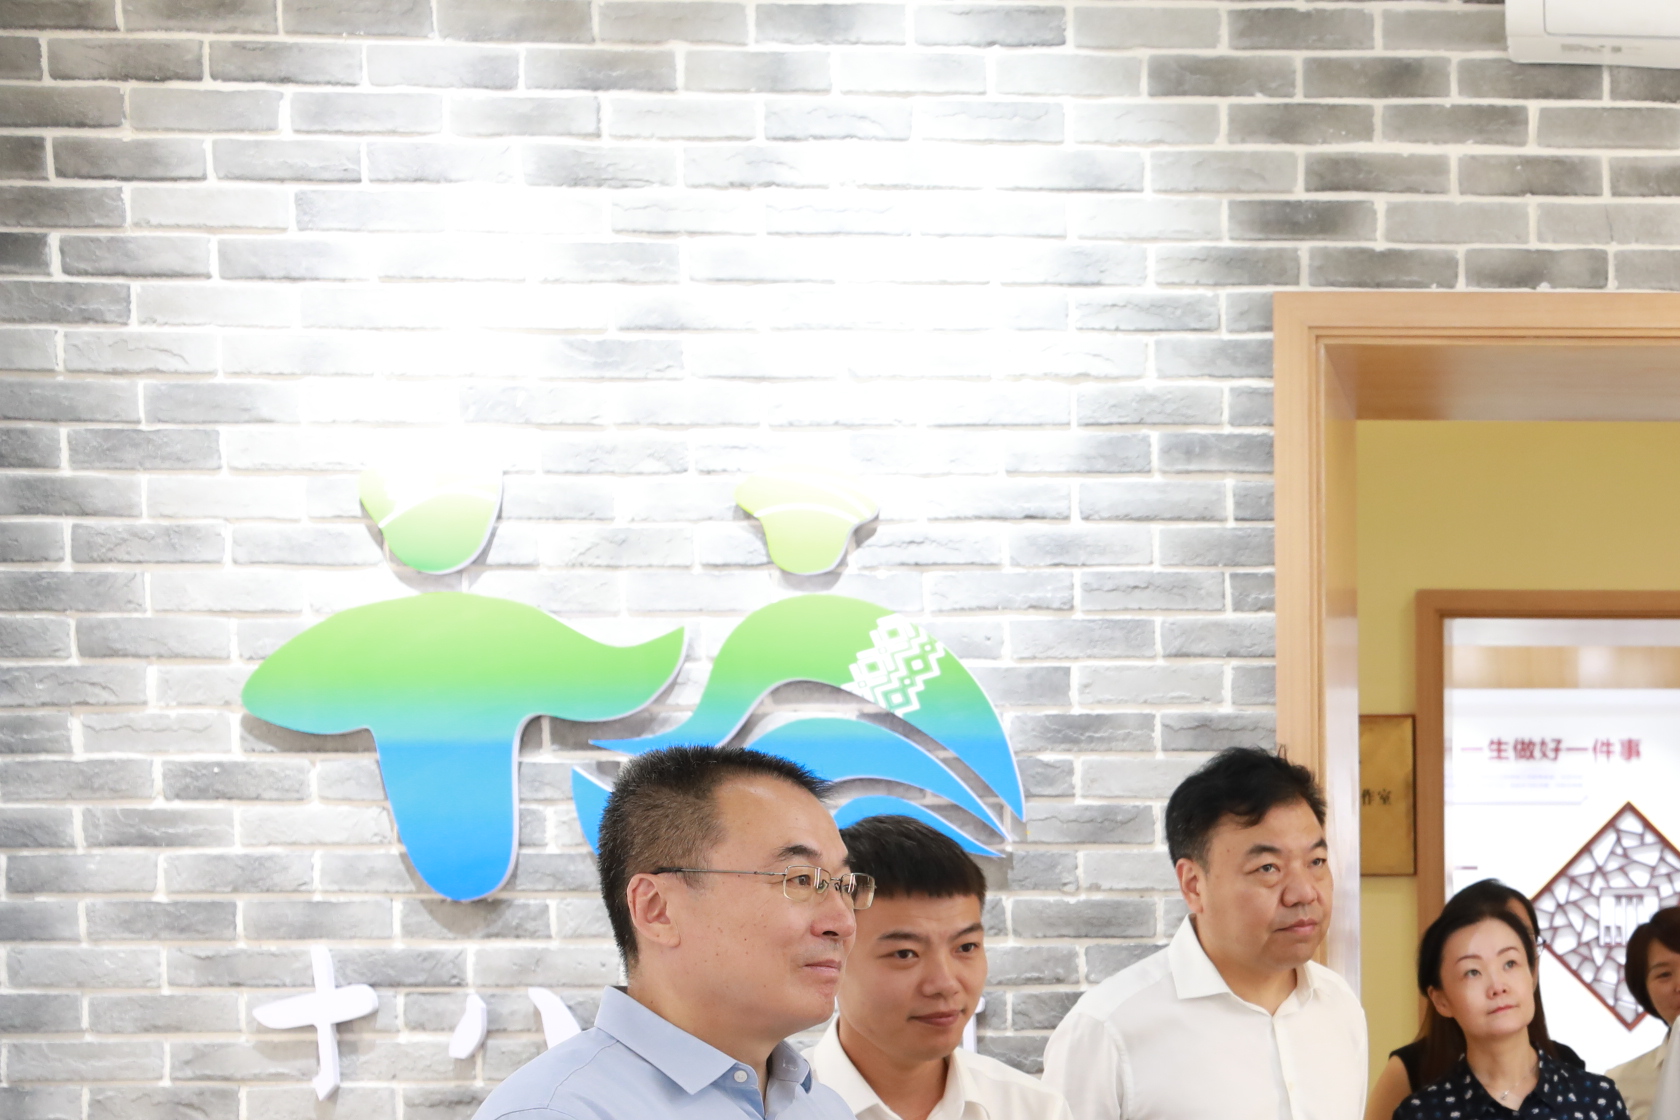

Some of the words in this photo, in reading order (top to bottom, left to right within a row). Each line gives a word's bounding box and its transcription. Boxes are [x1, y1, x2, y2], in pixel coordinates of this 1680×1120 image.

[1460, 737, 1642, 762] 一生做好一件事
